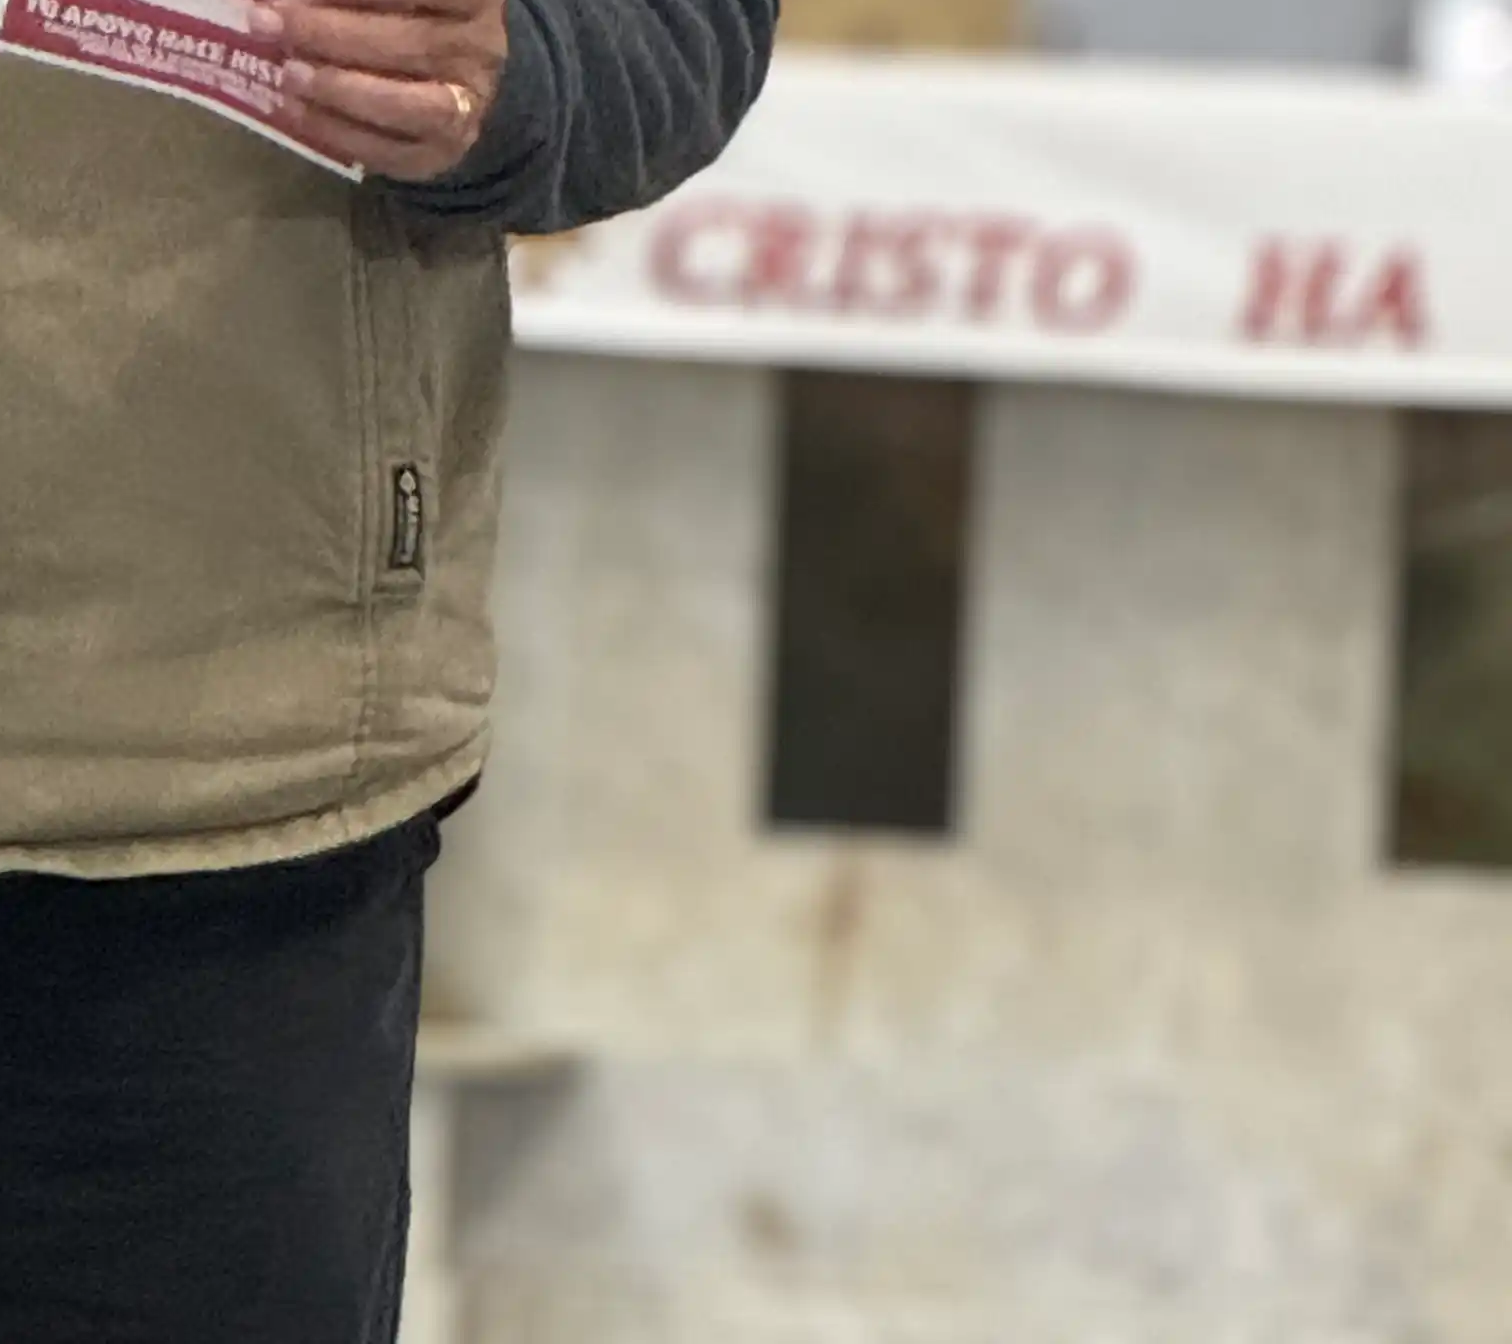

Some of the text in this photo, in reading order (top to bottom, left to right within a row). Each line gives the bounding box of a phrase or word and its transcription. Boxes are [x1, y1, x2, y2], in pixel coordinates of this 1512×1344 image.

[60, 4, 154, 46] APOYO
[645, 194, 1430, 348] CRISTO HA
